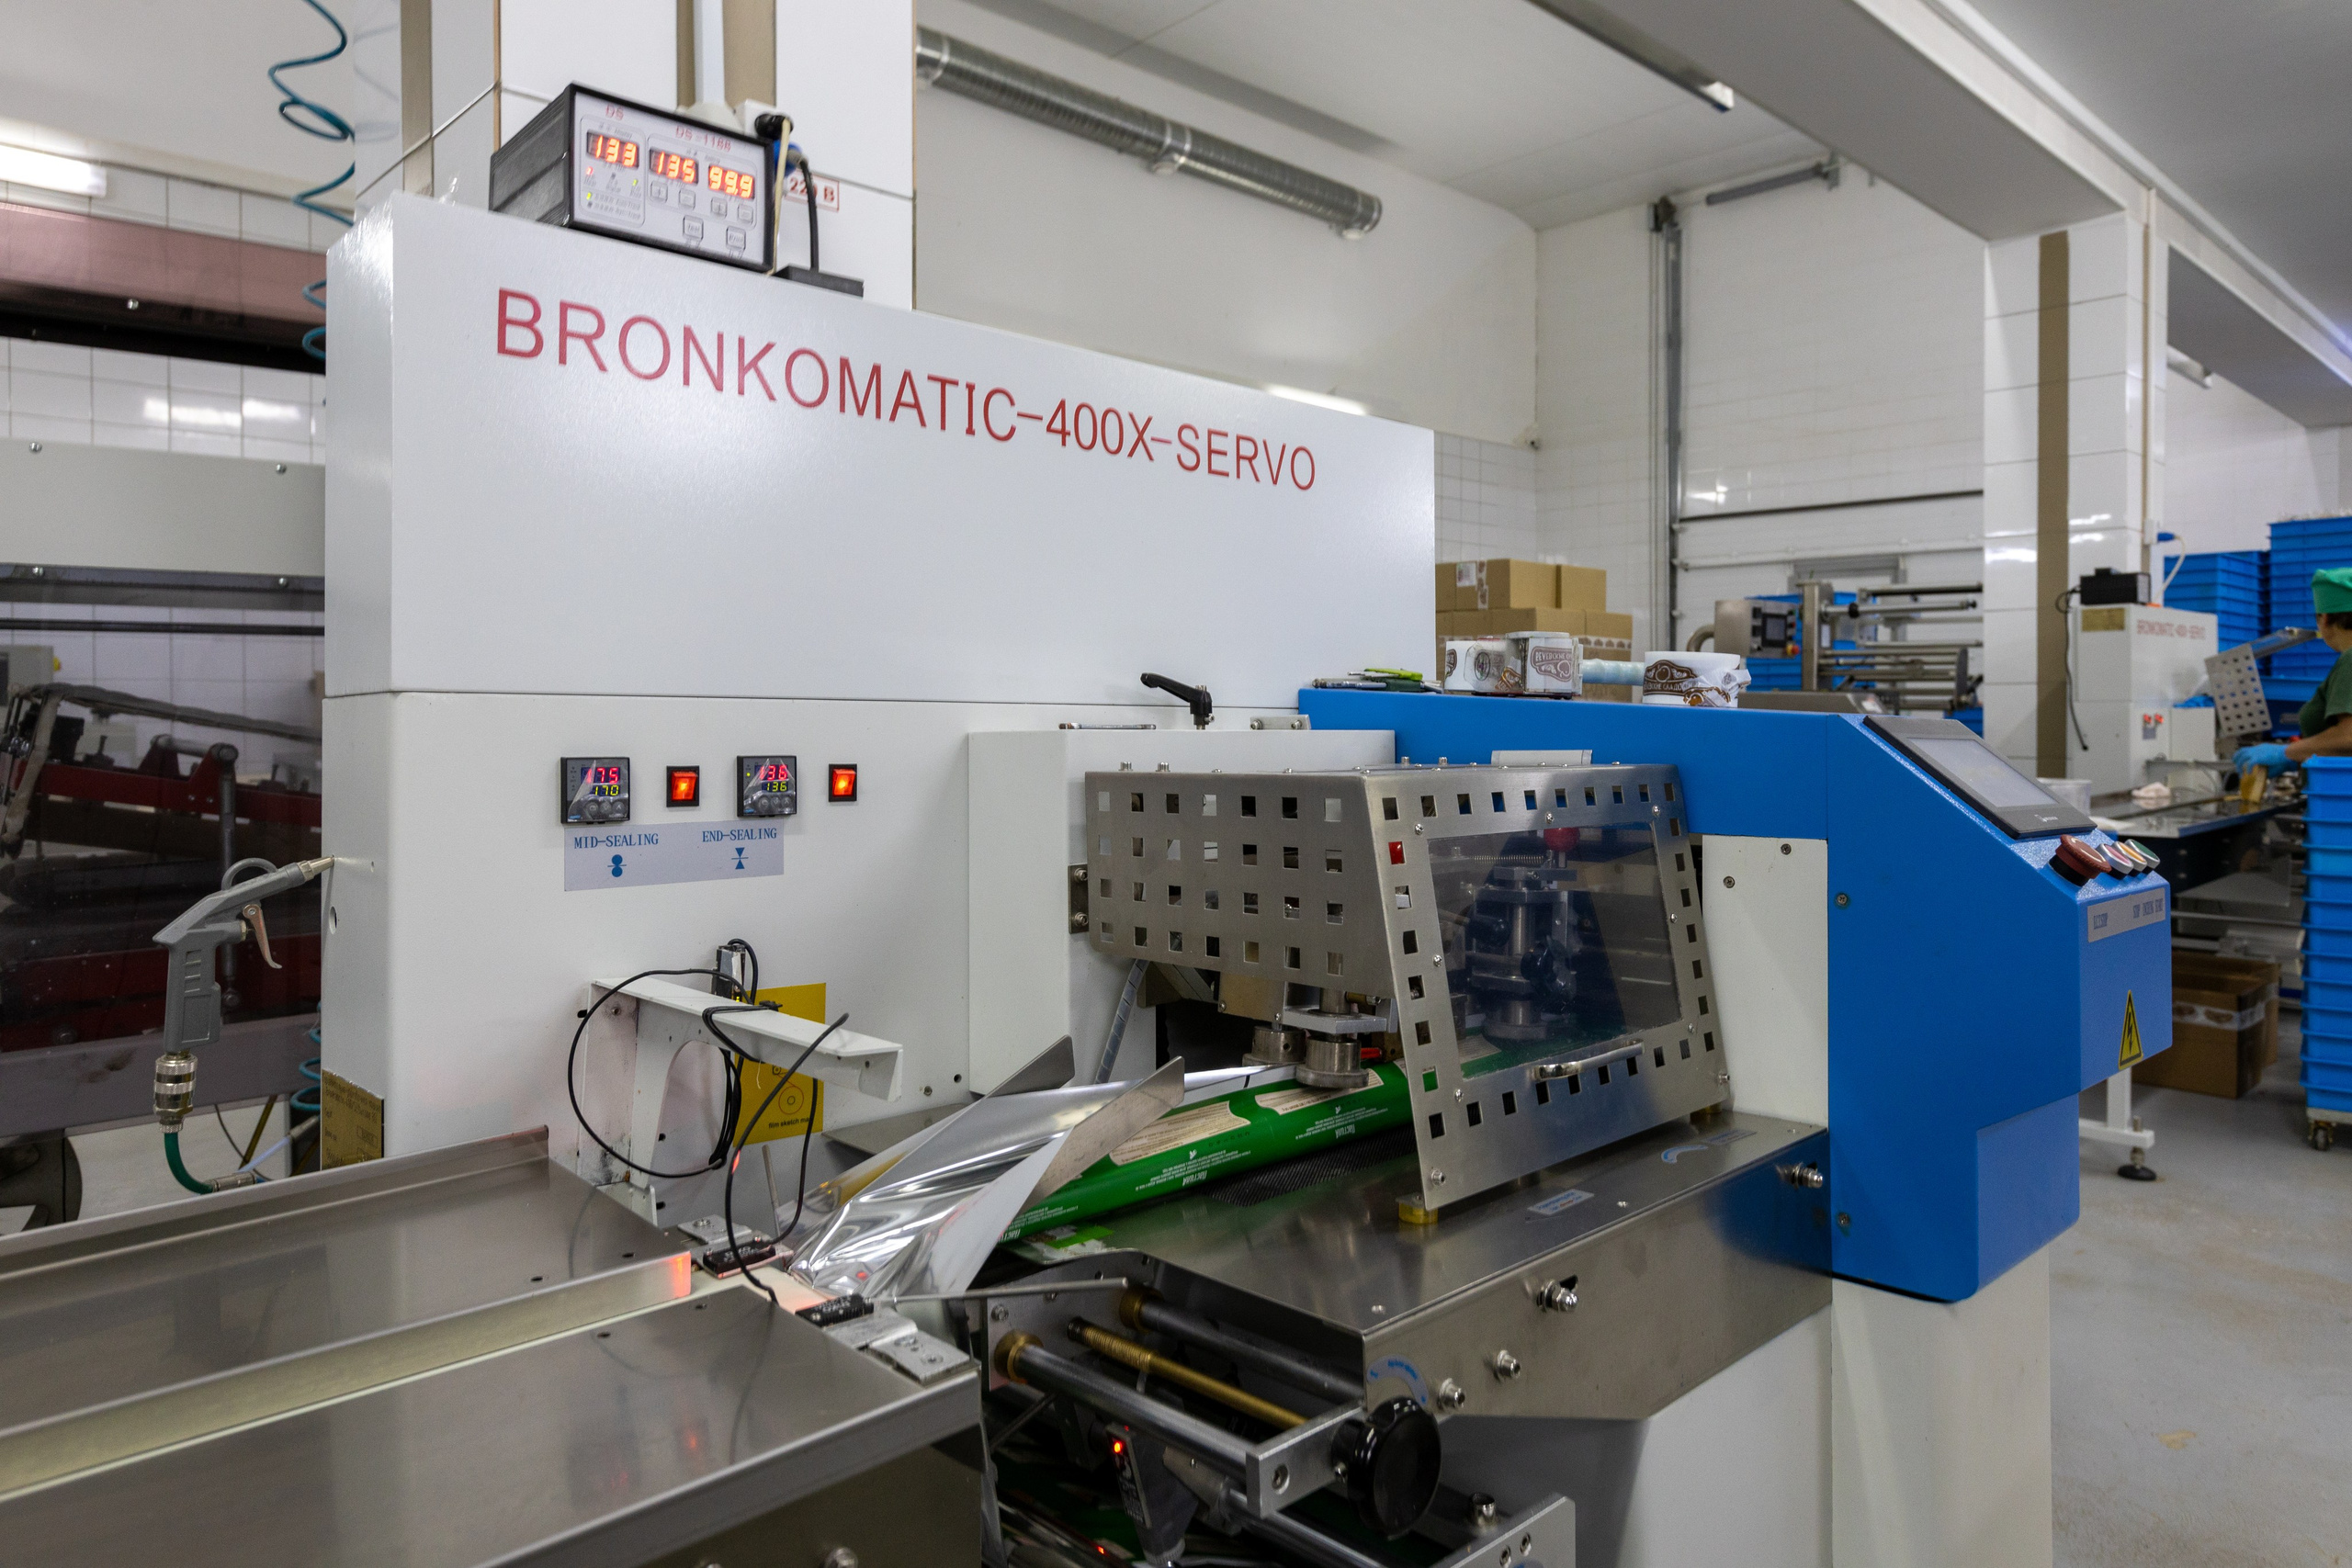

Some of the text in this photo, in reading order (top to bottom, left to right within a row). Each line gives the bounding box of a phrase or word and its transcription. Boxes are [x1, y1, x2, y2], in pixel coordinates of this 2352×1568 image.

[594, 135, 638, 167] 133
[657, 152, 695, 185] 135
[497, 288, 1316, 491] BRONKOMATIC-400X-SERVO
[594, 784, 619, 796] 170
[766, 781, 787, 792] 136
[574, 833, 660, 849] MID-SEALING
[702, 828, 777, 842] END-SEALING
[780, 1117, 800, 1127] sketch
